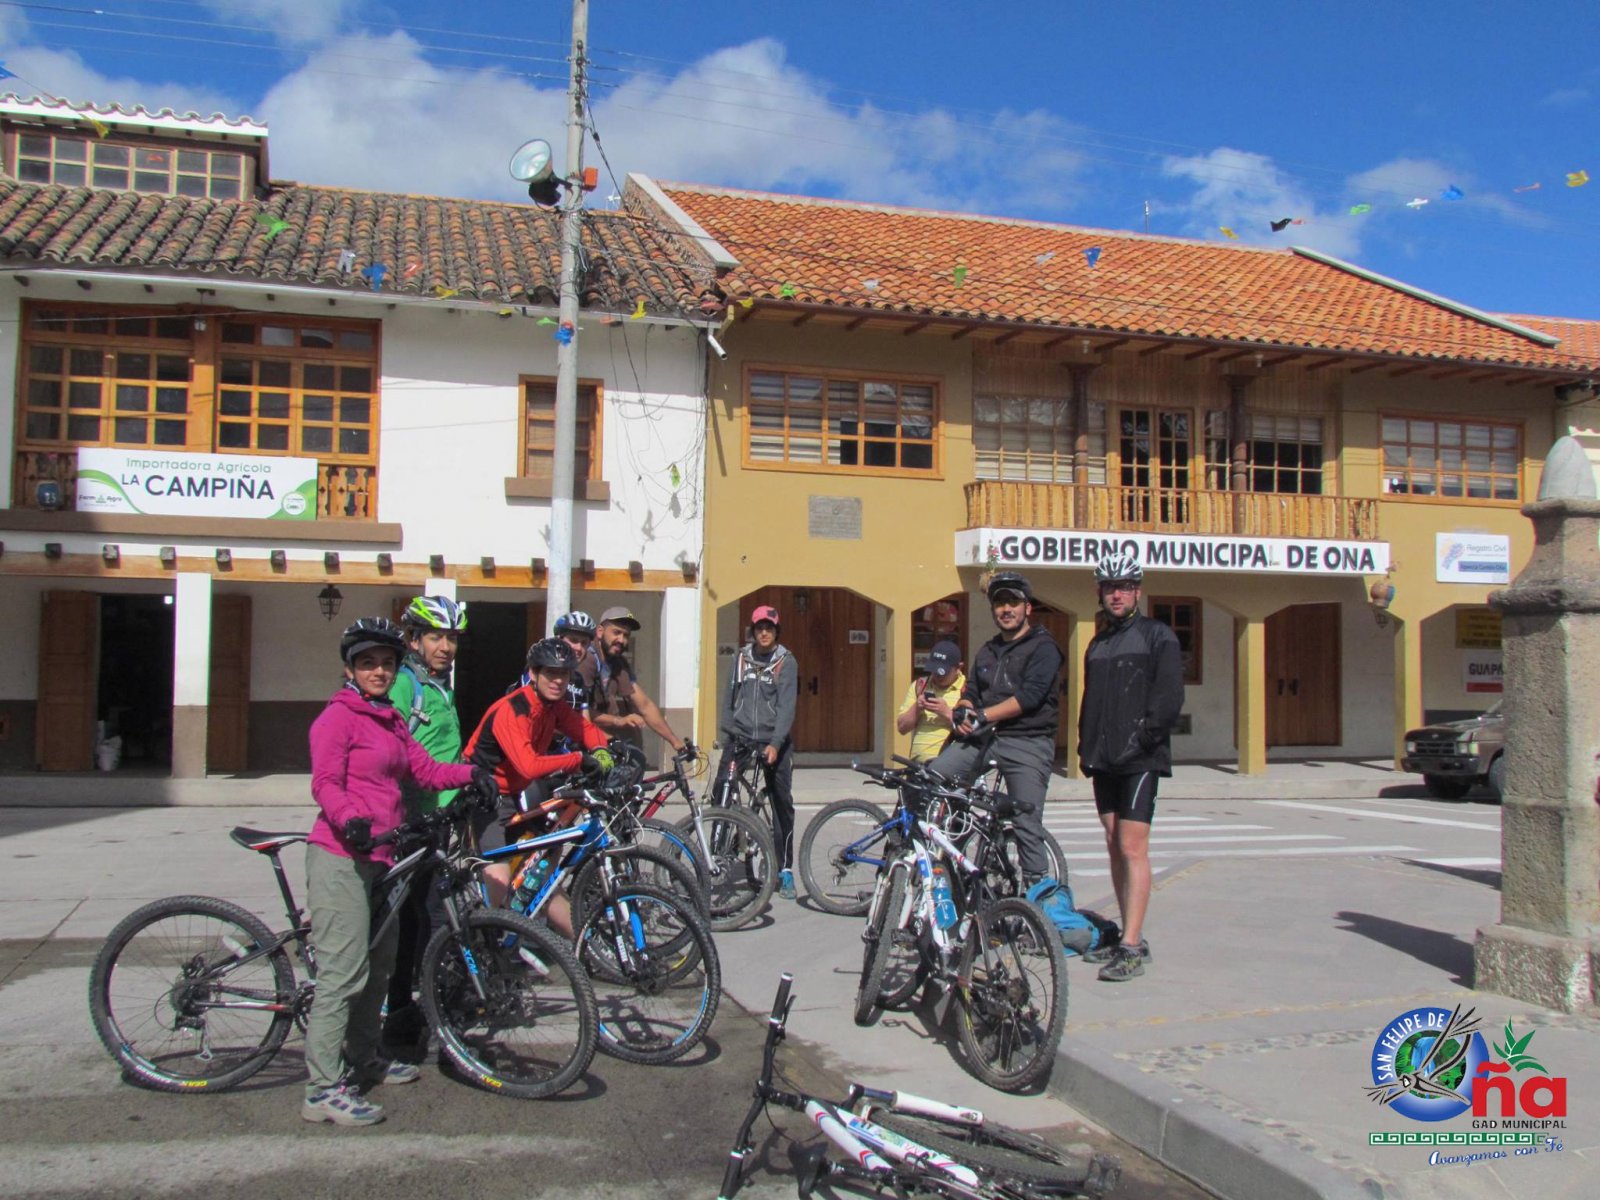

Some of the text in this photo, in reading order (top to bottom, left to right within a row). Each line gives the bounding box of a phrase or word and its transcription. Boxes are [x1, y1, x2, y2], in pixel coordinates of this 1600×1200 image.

[126, 457, 211, 471] Importadora
[121, 474, 275, 500] LA CAMPIÑA
[1000, 536, 1139, 562] GOBIERNO
[1287, 545, 1318, 569] DE
[1323, 546, 1375, 571] ONA
